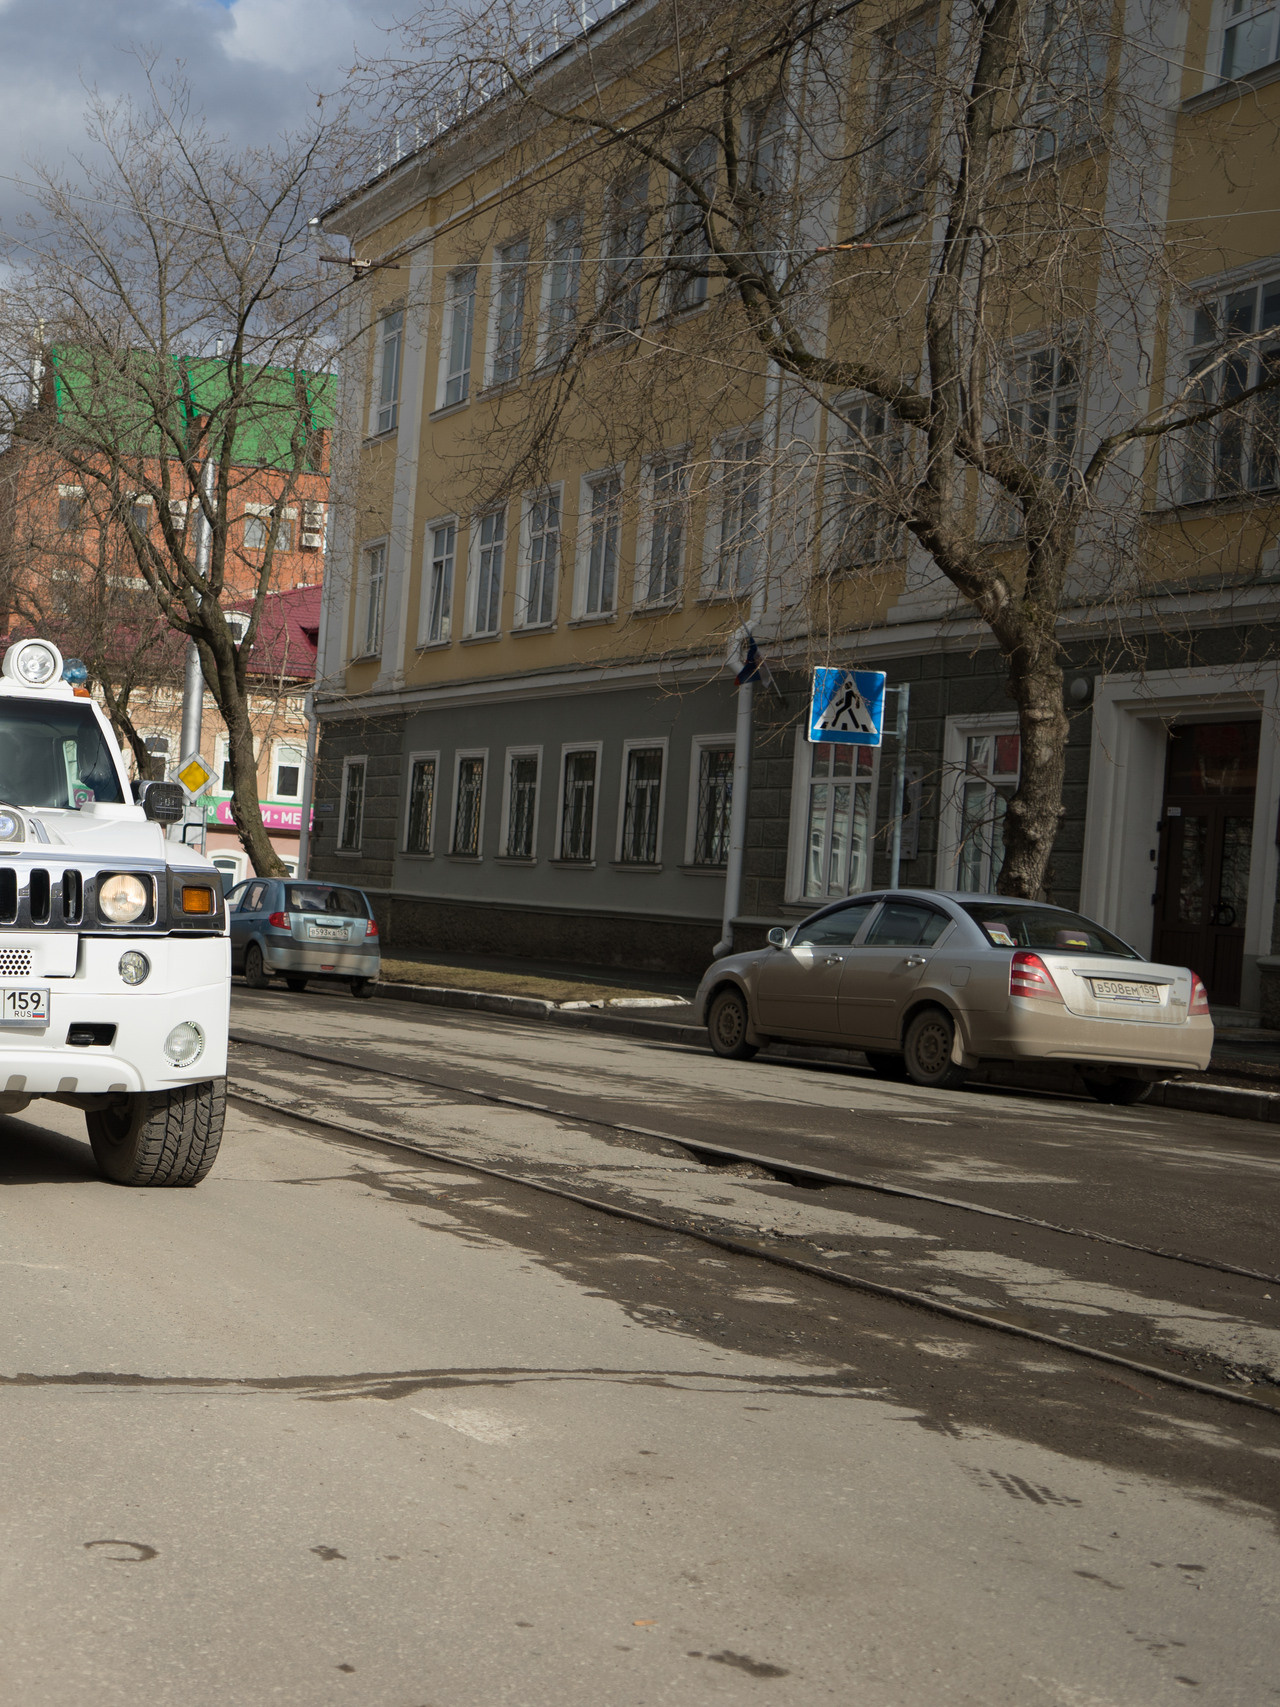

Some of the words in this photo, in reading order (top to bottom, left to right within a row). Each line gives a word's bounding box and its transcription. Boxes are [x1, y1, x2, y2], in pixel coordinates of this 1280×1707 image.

[1097, 982, 1139, 995] В508ЕМ
[1140, 985, 1155, 994] 159
[7, 992, 42, 1010] 159
[14, 1010, 32, 1018] RUS
